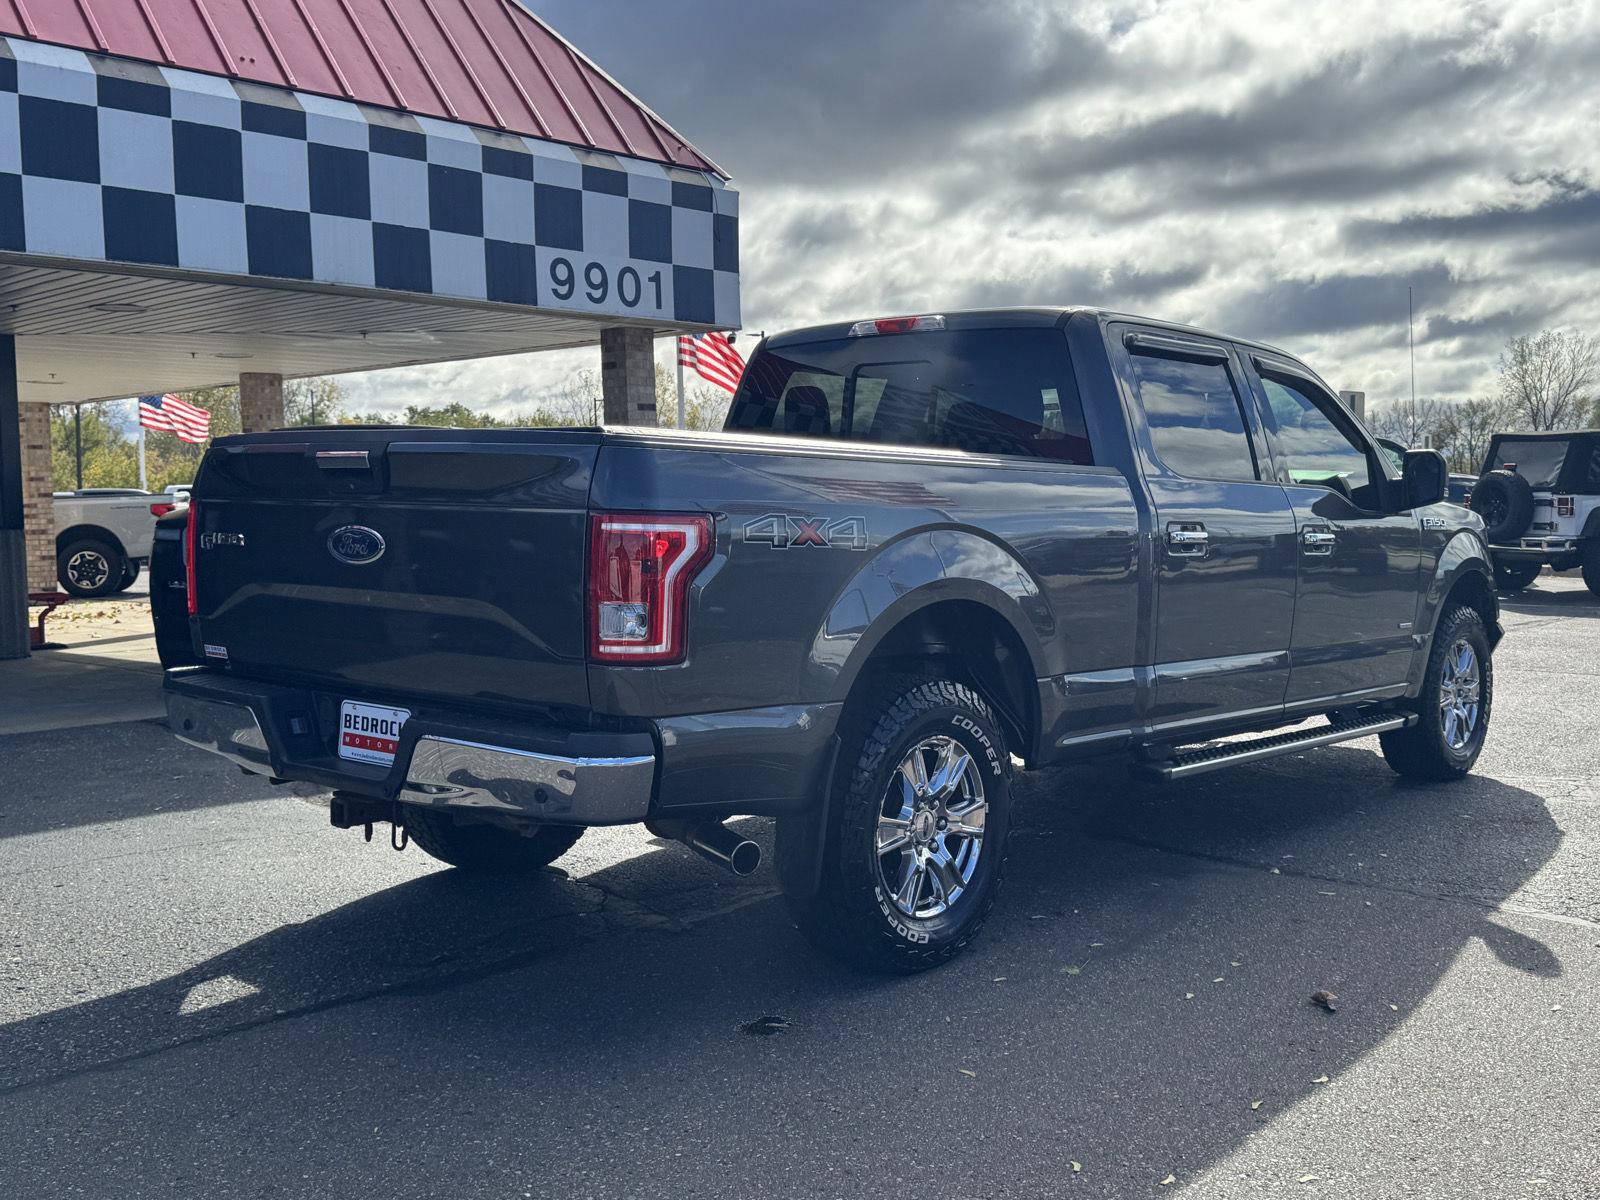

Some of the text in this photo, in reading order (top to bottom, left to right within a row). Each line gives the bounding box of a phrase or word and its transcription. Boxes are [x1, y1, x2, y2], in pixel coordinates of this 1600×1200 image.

[550, 257, 662, 309] 9901
[339, 533, 368, 554] Ford
[951, 714, 1002, 776] COOPER
[874, 886, 930, 944] COOPER
